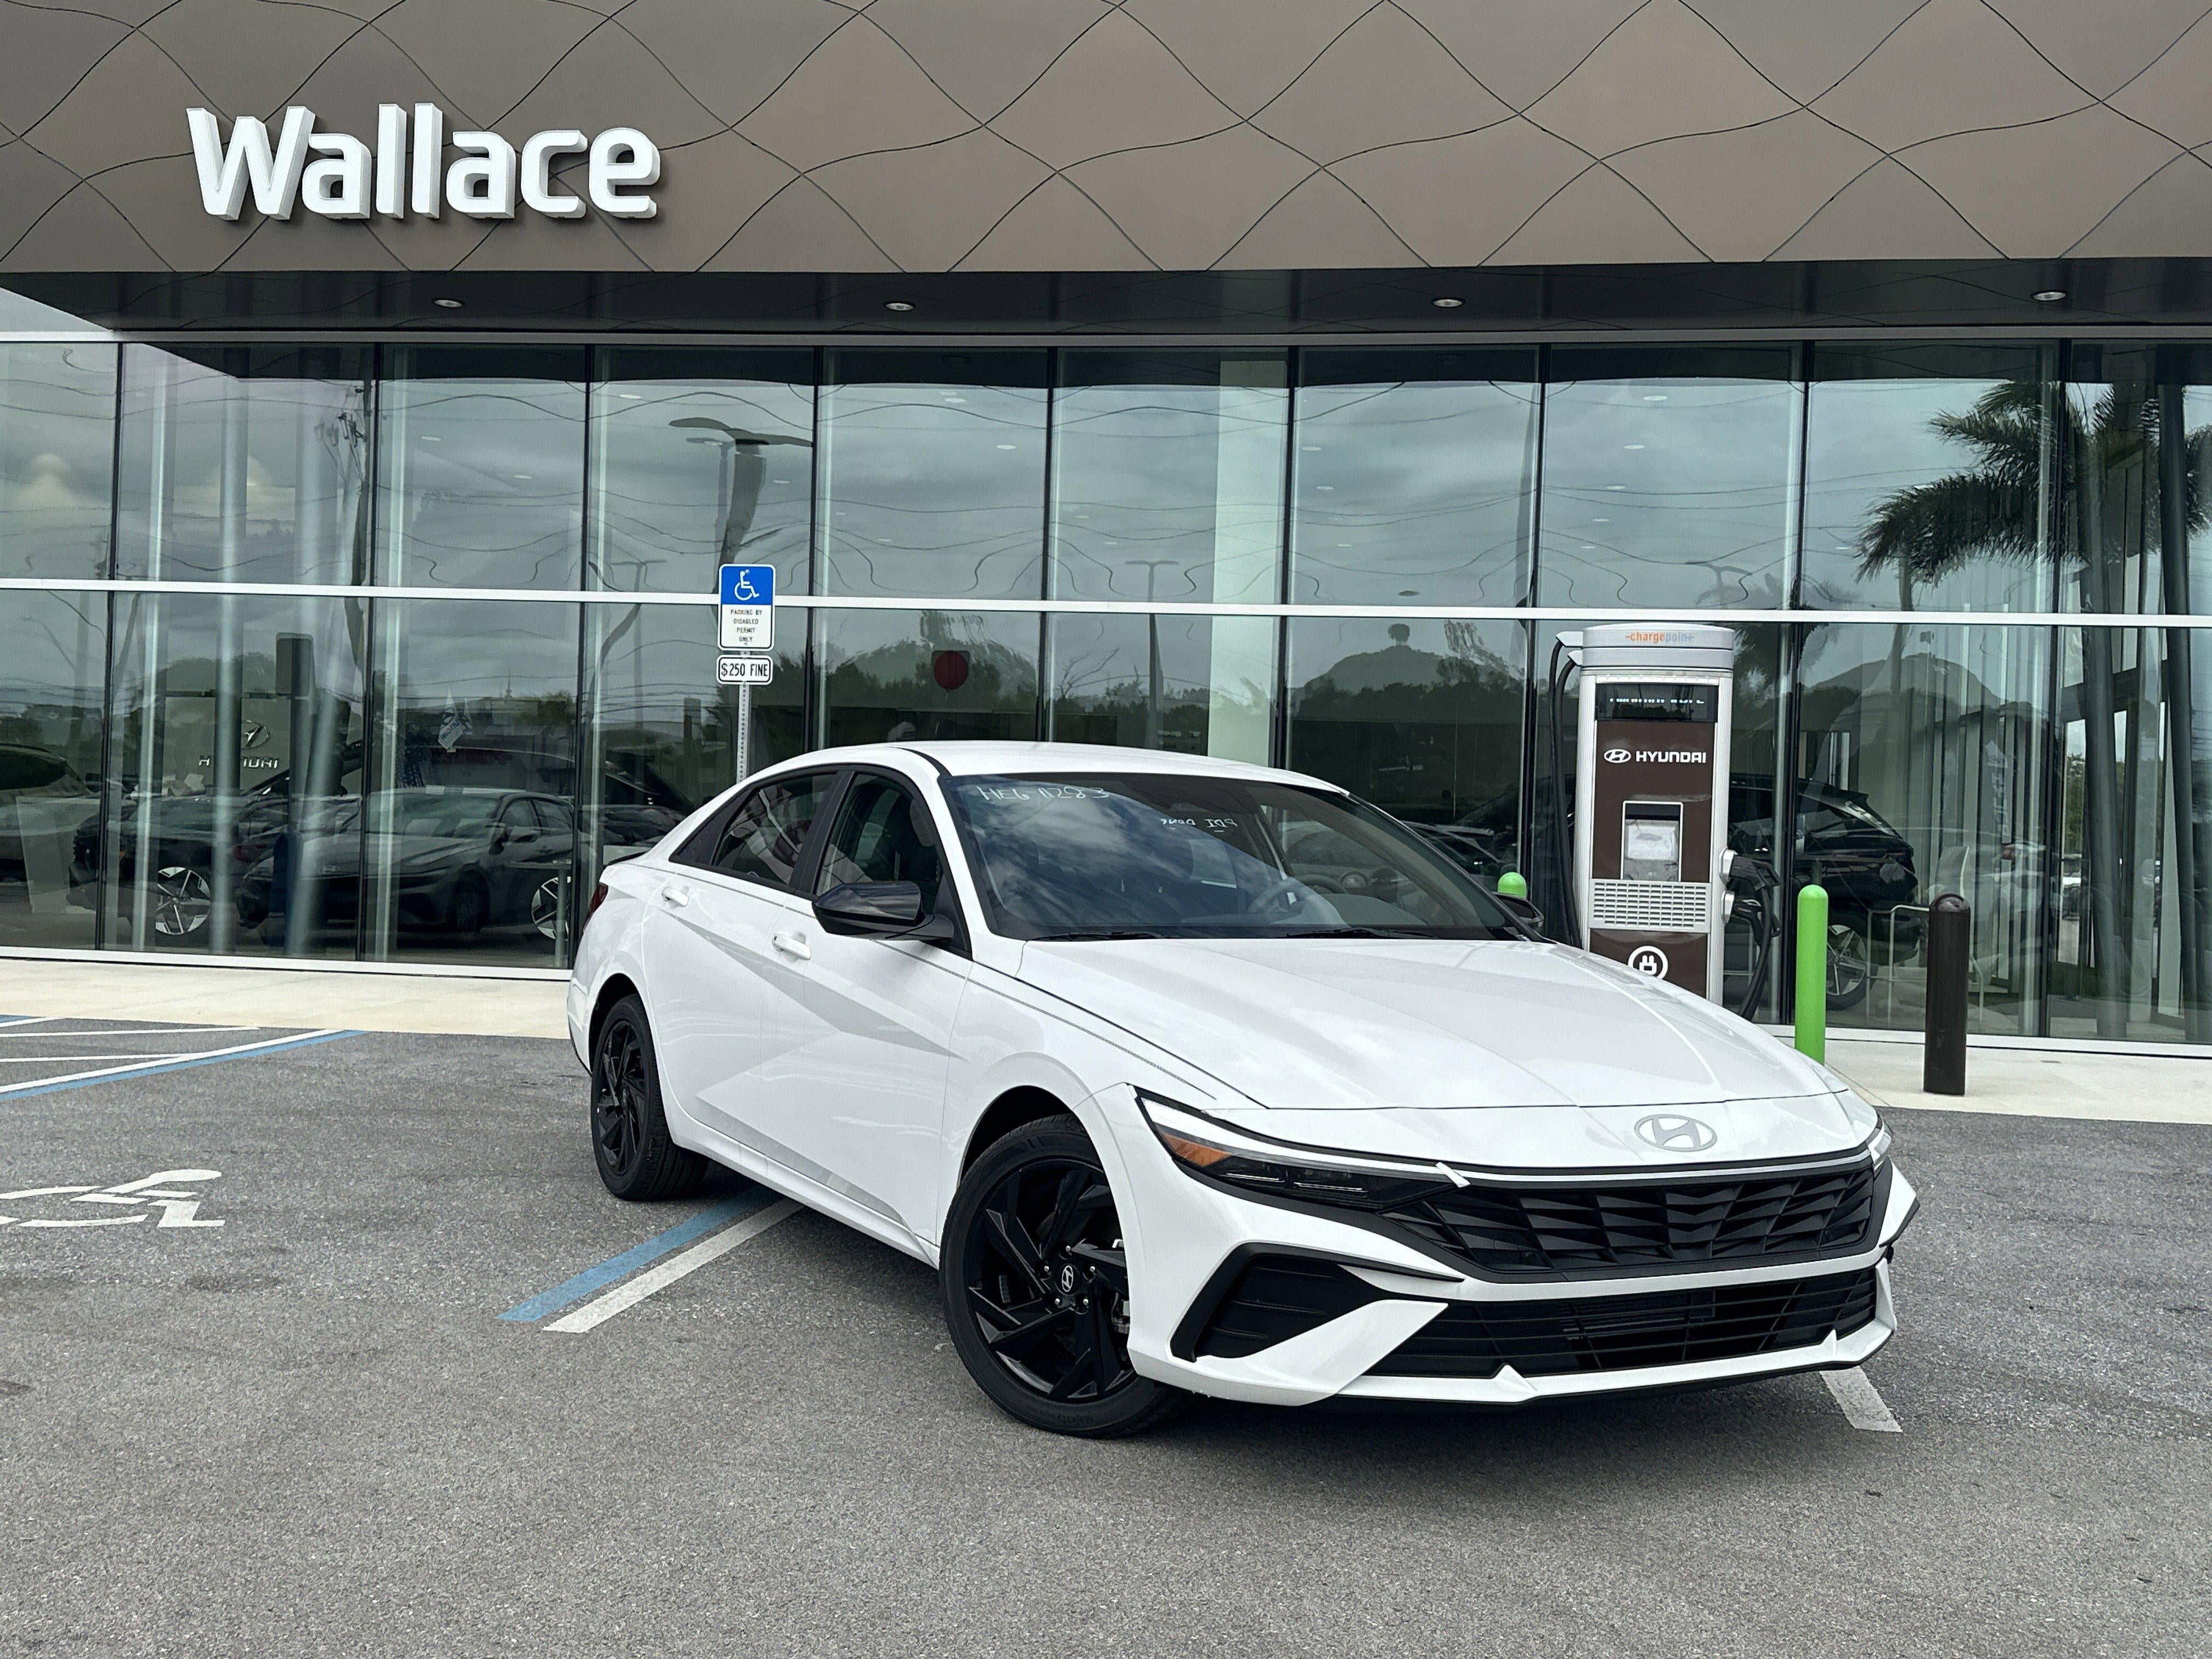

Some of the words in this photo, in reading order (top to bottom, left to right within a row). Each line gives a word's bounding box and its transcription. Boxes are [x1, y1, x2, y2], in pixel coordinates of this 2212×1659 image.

[187, 103, 660, 219] Wallace
[721, 662, 746, 677] $250
[750, 663, 768, 677] FINE
[1635, 751, 1707, 763] HYUNDAI
